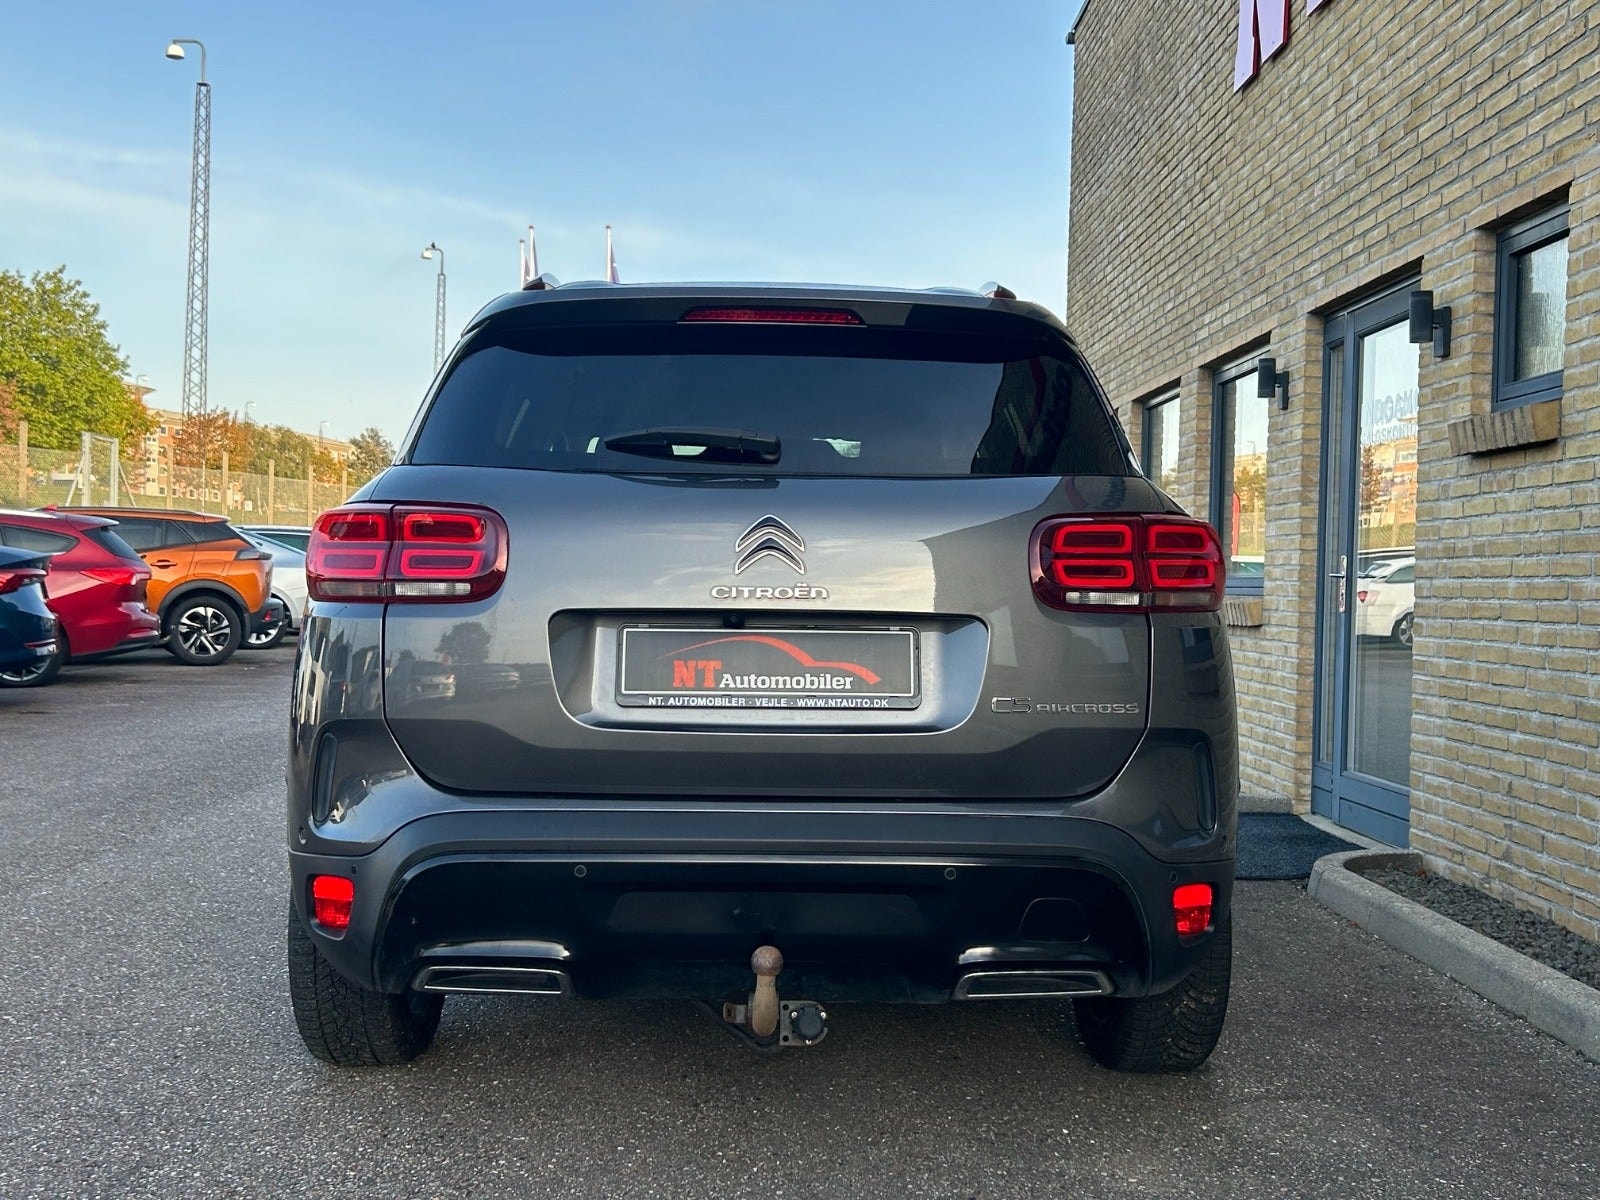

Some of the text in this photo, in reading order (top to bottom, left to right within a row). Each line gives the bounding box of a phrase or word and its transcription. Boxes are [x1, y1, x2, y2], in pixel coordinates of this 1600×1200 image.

[672, 660, 854, 689] NT Automobiler
[667, 697, 746, 707] AUTOMOBILER
[755, 698, 788, 707] VEJLE
[796, 698, 889, 708] WWW.NTAUTO.DK
[991, 697, 1140, 715] C5 AIRCROSS
